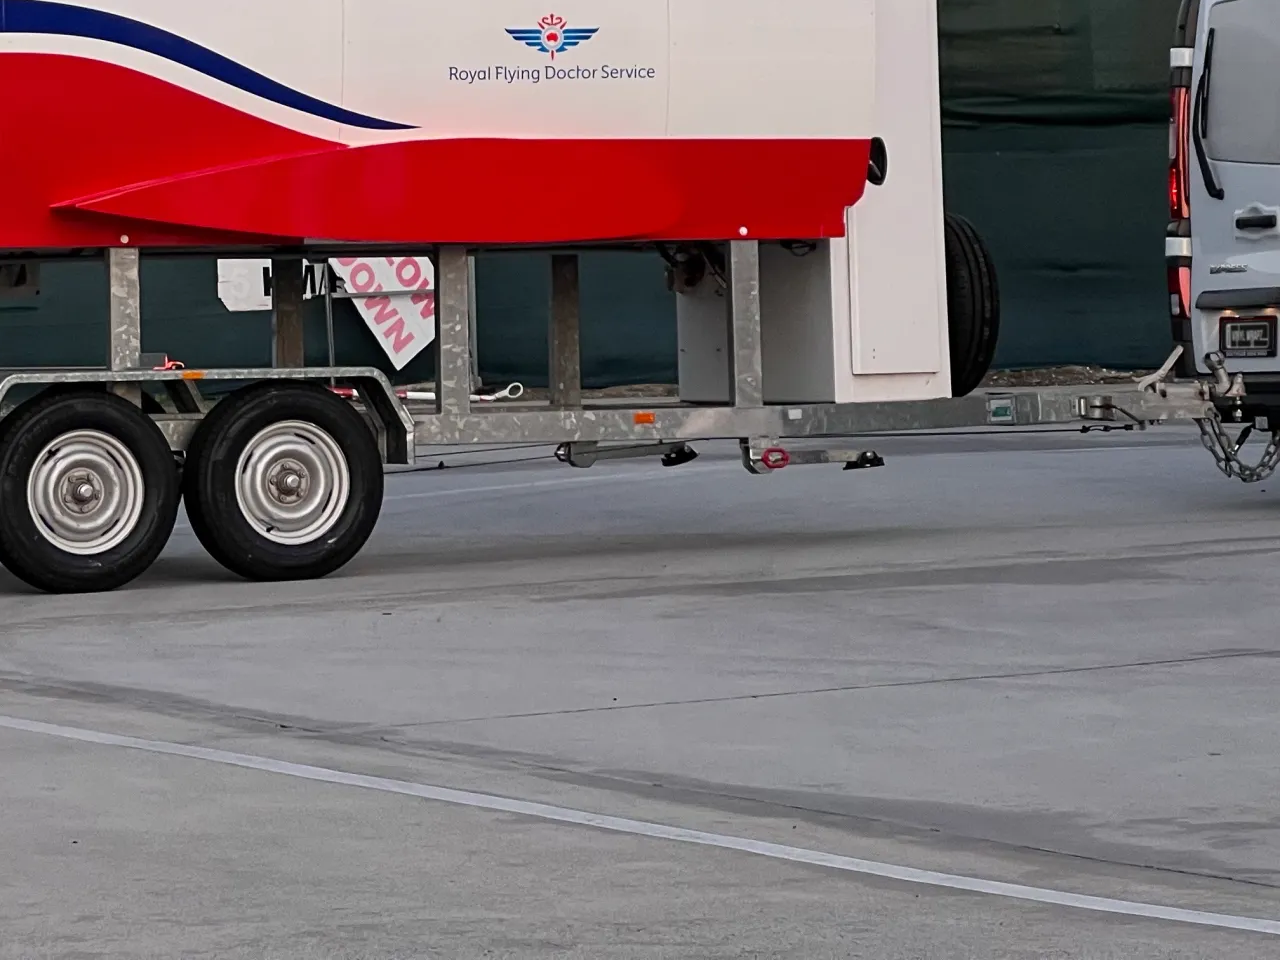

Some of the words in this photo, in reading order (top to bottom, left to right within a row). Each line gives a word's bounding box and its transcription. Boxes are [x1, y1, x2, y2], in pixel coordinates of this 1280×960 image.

[449, 66, 491, 84] Royal
[495, 66, 540, 83] Flying
[544, 65, 598, 80] Doctor
[601, 65, 656, 79] Service
[336, 258, 415, 354] OWN
